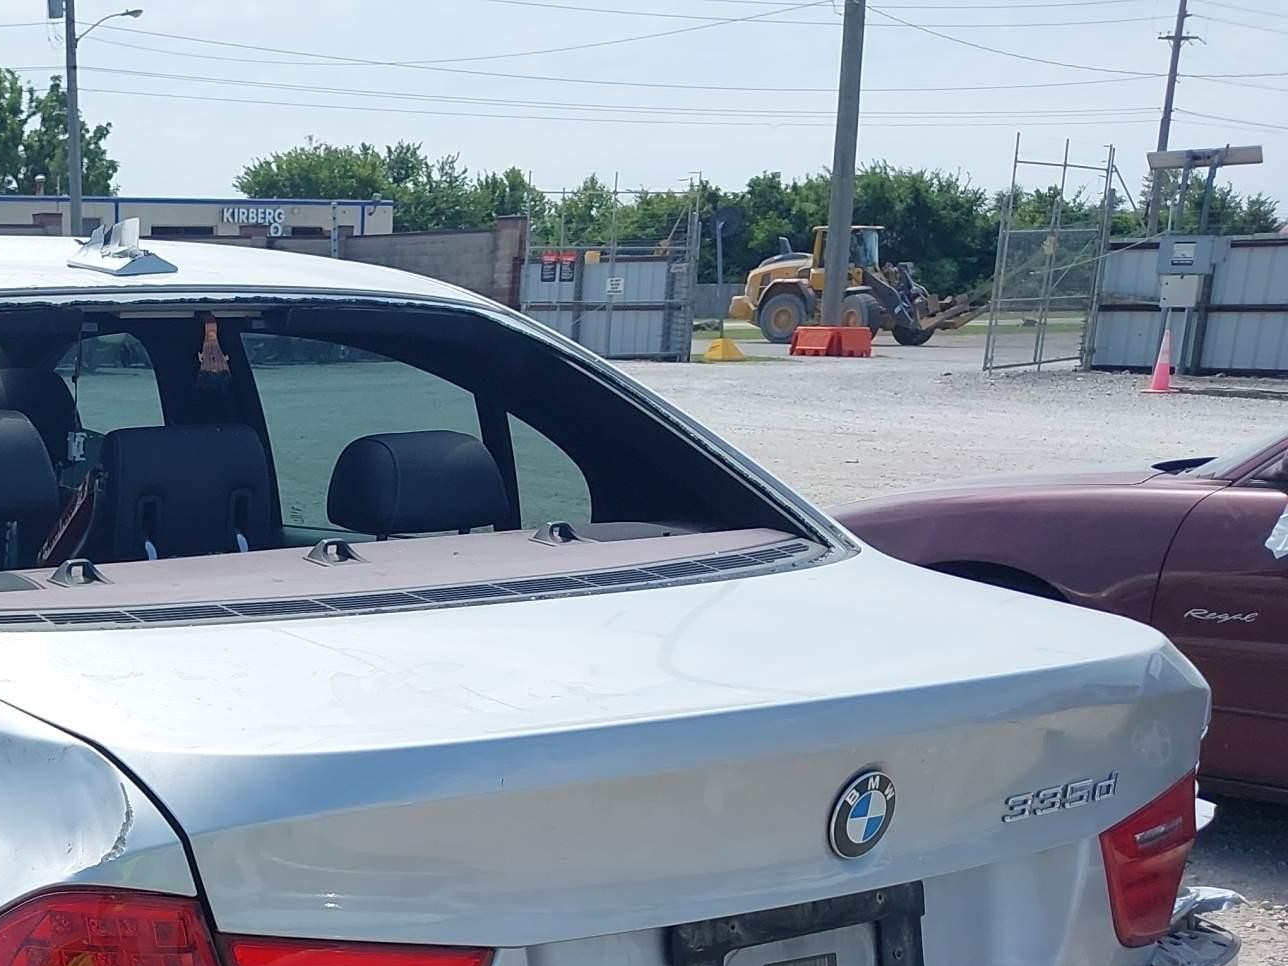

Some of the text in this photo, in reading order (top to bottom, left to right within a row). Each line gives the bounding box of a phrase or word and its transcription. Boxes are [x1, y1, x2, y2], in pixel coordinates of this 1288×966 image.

[223, 207, 285, 224] KIRBERG
[1184, 608, 1258, 623] Regal
[845, 775, 895, 806] BMW
[1001, 770, 1118, 823] 335d
